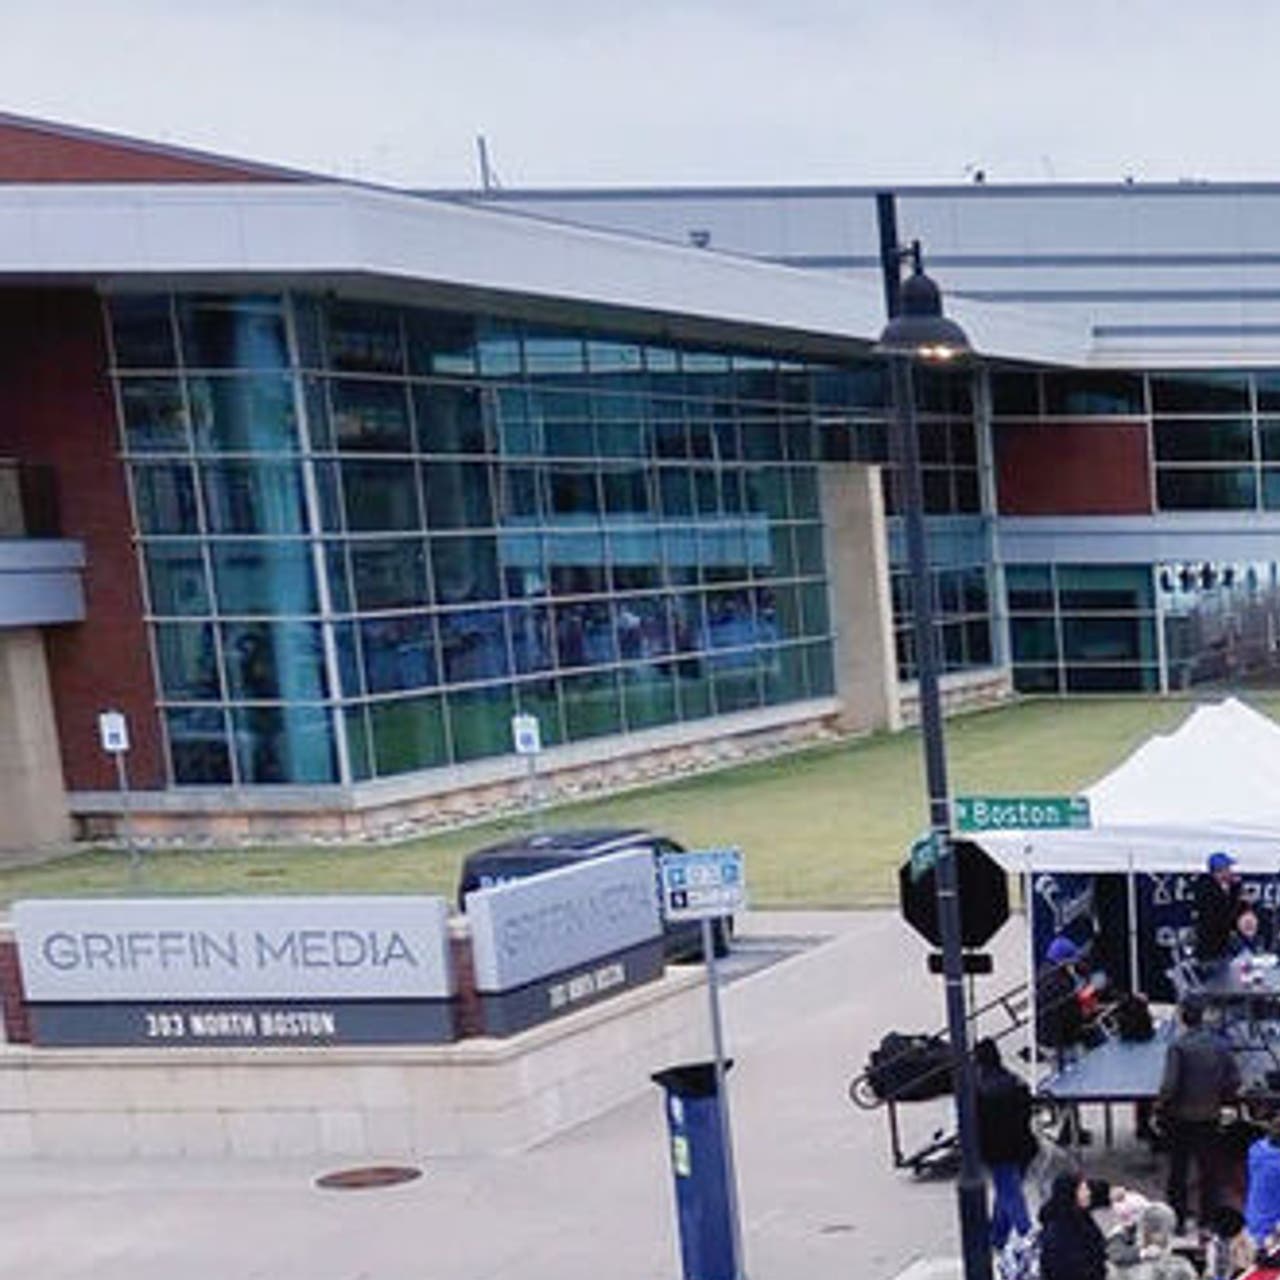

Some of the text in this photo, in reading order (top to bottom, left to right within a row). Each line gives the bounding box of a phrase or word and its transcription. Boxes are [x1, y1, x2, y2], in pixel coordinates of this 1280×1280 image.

[973, 801, 1060, 827] Boston
[43, 930, 419, 972] GRIFFIN MEDIA
[146, 1011, 335, 1037] 303 NORTH BOSTON
